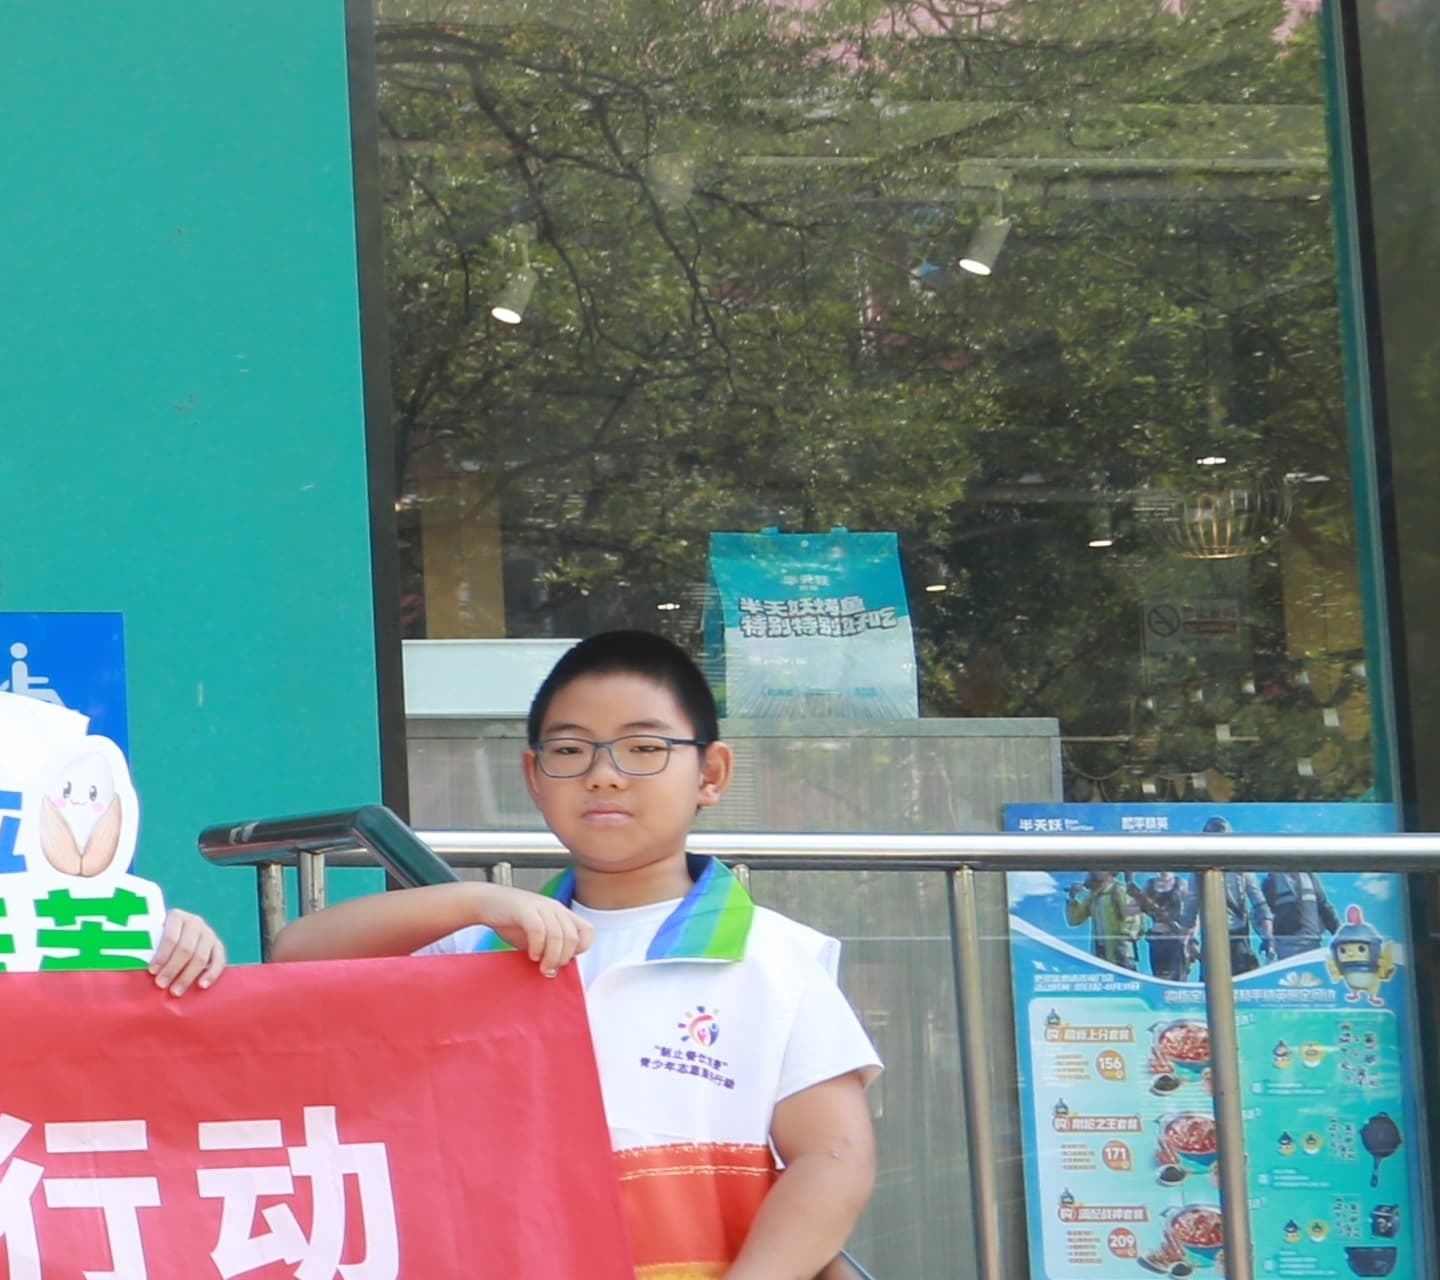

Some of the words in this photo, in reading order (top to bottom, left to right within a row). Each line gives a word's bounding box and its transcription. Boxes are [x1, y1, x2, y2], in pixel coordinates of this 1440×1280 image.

[1098, 1057, 1122, 1070] 156
[1104, 1147, 1128, 1161] 171
[1110, 1235, 1135, 1248] 209
